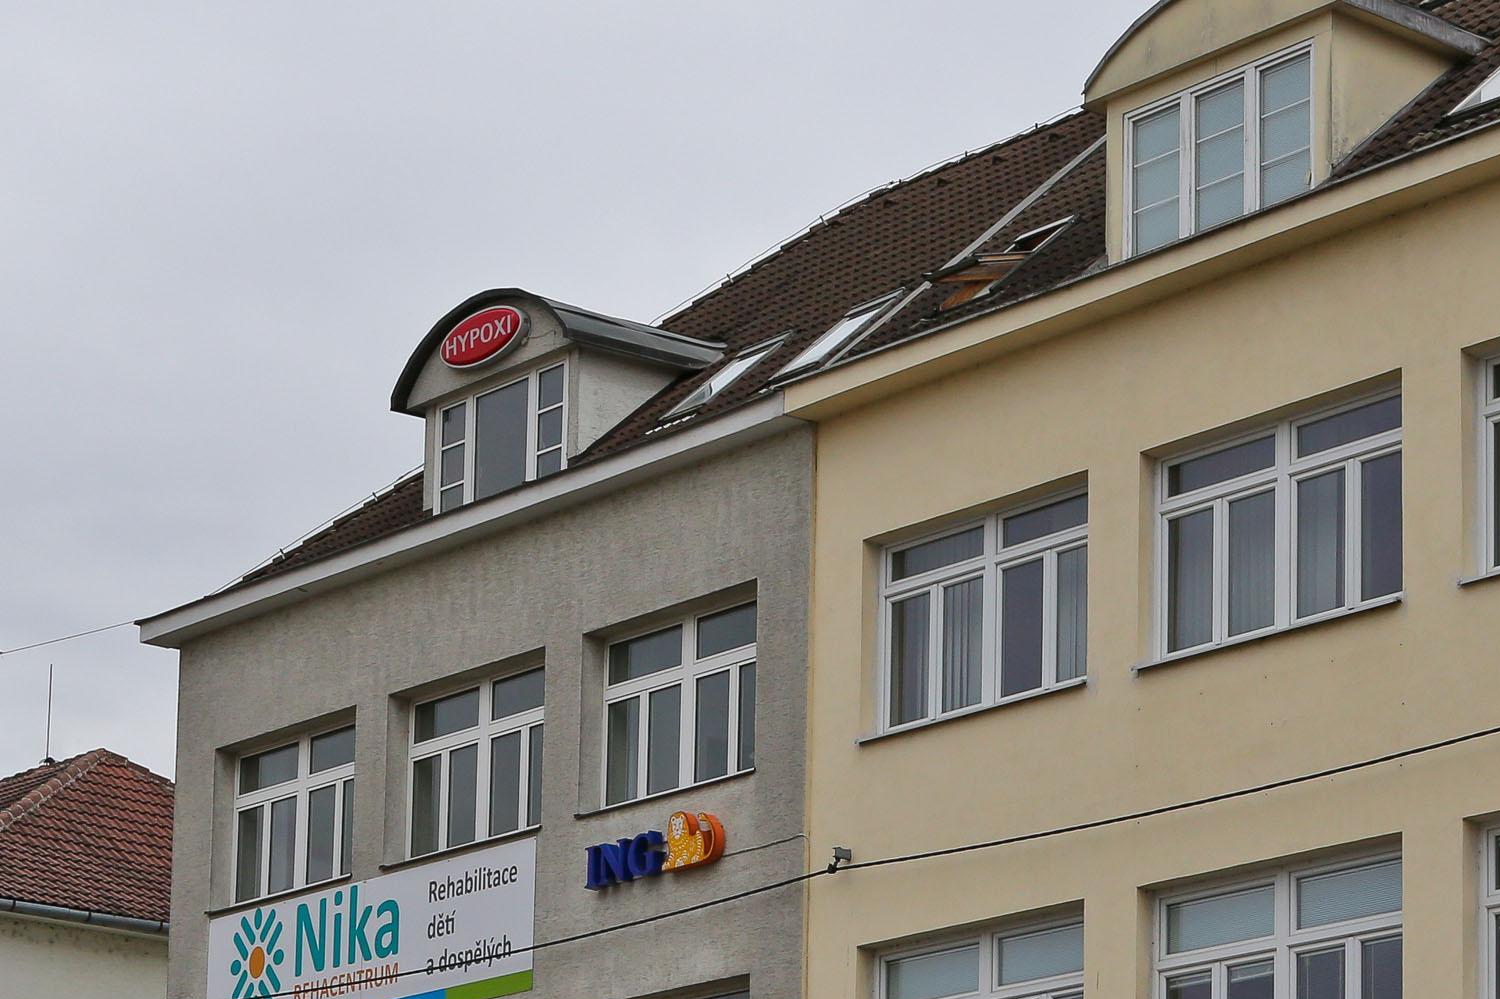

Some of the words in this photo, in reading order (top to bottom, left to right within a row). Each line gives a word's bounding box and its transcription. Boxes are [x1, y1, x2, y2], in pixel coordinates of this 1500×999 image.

[445, 315, 512, 359] HYPOXI
[584, 830, 667, 891] ING
[428, 864, 518, 903] Rehabilitace
[294, 885, 400, 977] Nika
[427, 910, 456, 939] dětí
[426, 957, 435, 976] a
[438, 935, 512, 974] dospělých
